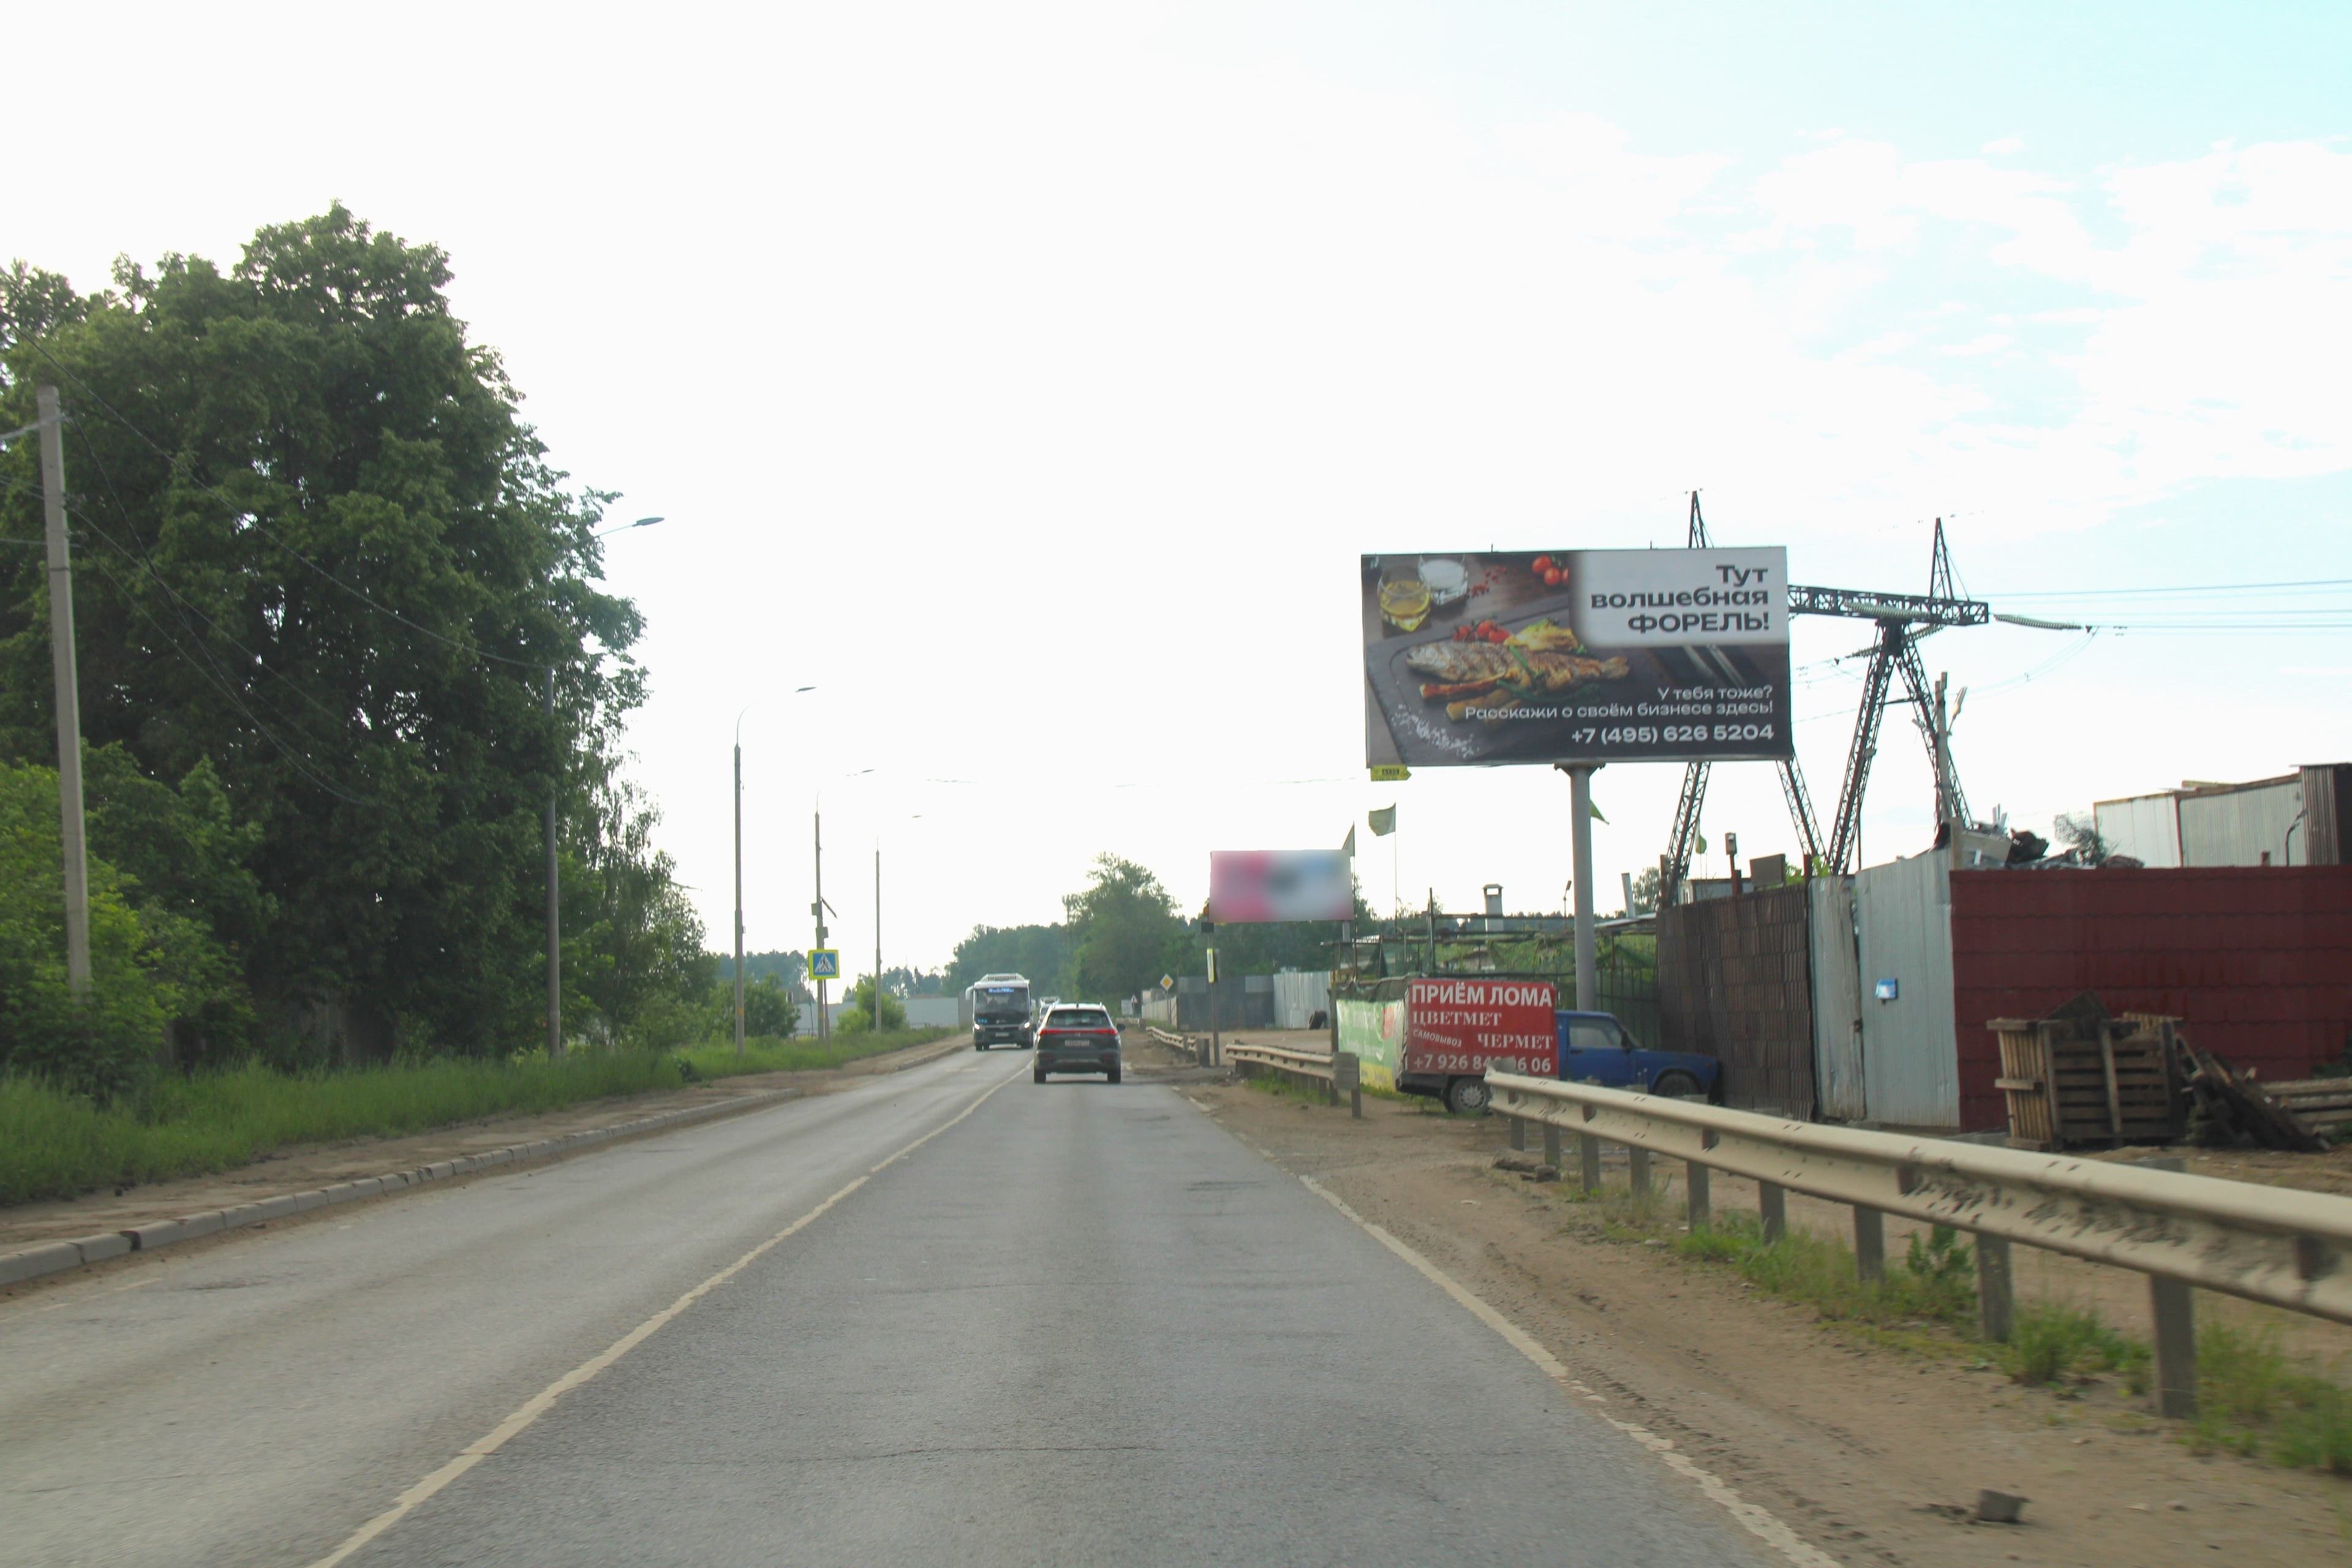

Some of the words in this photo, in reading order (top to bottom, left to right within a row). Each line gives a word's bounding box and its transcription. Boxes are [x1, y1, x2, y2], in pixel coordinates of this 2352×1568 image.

[1716, 564, 1768, 587] Тут
[1591, 586, 1769, 608] волшебная
[1627, 611, 1770, 634] ФОРЕЛЬ!
[1657, 687, 1670, 701] У
[1672, 685, 1714, 700] тебя
[1717, 684, 1773, 699] тоже?
[1465, 706, 1558, 720] Расскажи
[1562, 706, 1573, 718] о
[1577, 703, 1633, 718] своём
[1637, 702, 1713, 717] бизнесе
[1716, 700, 1773, 716] здесь!
[1571, 727, 1596, 744] +7
[1601, 725, 1658, 745] (495)
[1663, 725, 1708, 742] 626
[1713, 723, 1774, 741] 5204
[1411, 981, 1485, 1005] ПРИЁМ
[1489, 986, 1553, 1008] ЛОМА
[1412, 1011, 1502, 1027] ЦВЕТМЕТ
[1412, 1028, 1463, 1047] САМОВЫВОЗ
[1477, 1033, 1554, 1050] ЧЕРМЕТ
[1414, 1054, 1434, 1069] +7
[1438, 1054, 1469, 1071] 926
[1531, 1057, 1551, 1073] 06
